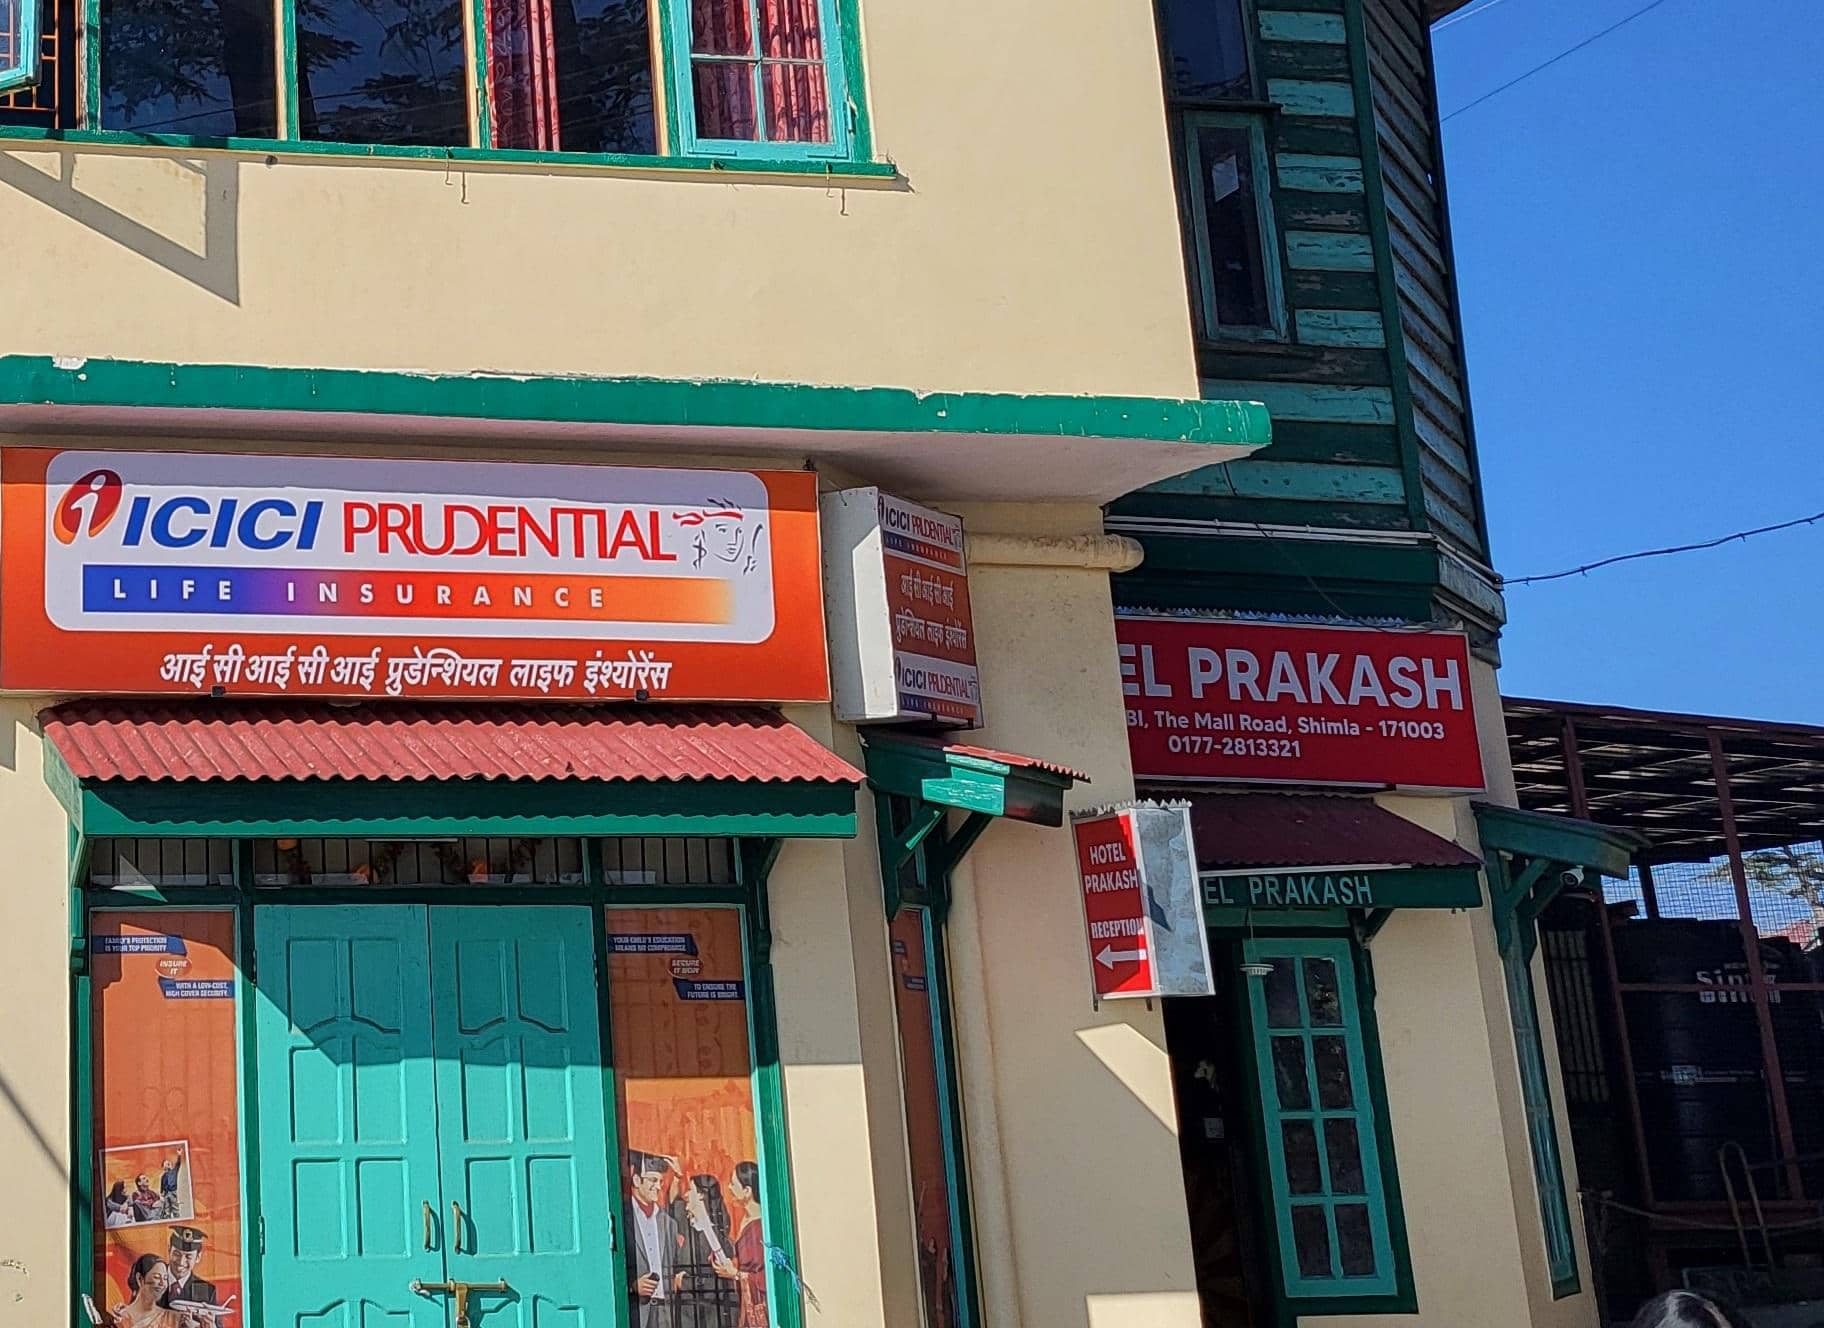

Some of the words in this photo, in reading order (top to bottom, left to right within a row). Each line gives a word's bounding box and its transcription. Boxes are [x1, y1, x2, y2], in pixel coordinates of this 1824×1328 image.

[122, 496, 324, 550] ICICI
[343, 501, 677, 562] PRUDENTIAL
[886, 507, 910, 531] ICICI
[912, 514, 953, 545] PRUDENTIAL
[113, 578, 231, 601] LIFE
[287, 582, 604, 608] INSURANCE
[160, 644, 213, 688] आई
[213, 644, 245, 683] सी
[245, 646, 297, 690] आई
[297, 645, 329, 684] सी
[330, 647, 381, 691] आई
[510, 659, 577, 693] लाइफ
[583, 650, 673, 694] इंश्योरेंस
[902, 667, 926, 689] ICICI
[928, 672, 970, 698] PRUDENTIAL
[1188, 646, 1463, 710] PRAKASH
[1154, 710, 1188, 728] The
[1195, 712, 1234, 731] Mall
[1240, 715, 1293, 734] Road,
[1297, 716, 1360, 736] Shimla
[1379, 720, 1445, 739] 171003
[1168, 735, 1301, 757] 0177-2813321
[1090, 843, 1126, 865] HOTEL
[1085, 869, 1138, 893] PRAKASH
[1248, 875, 1373, 904] PRAKASH
[1091, 918, 1144, 939] RECEPTION
